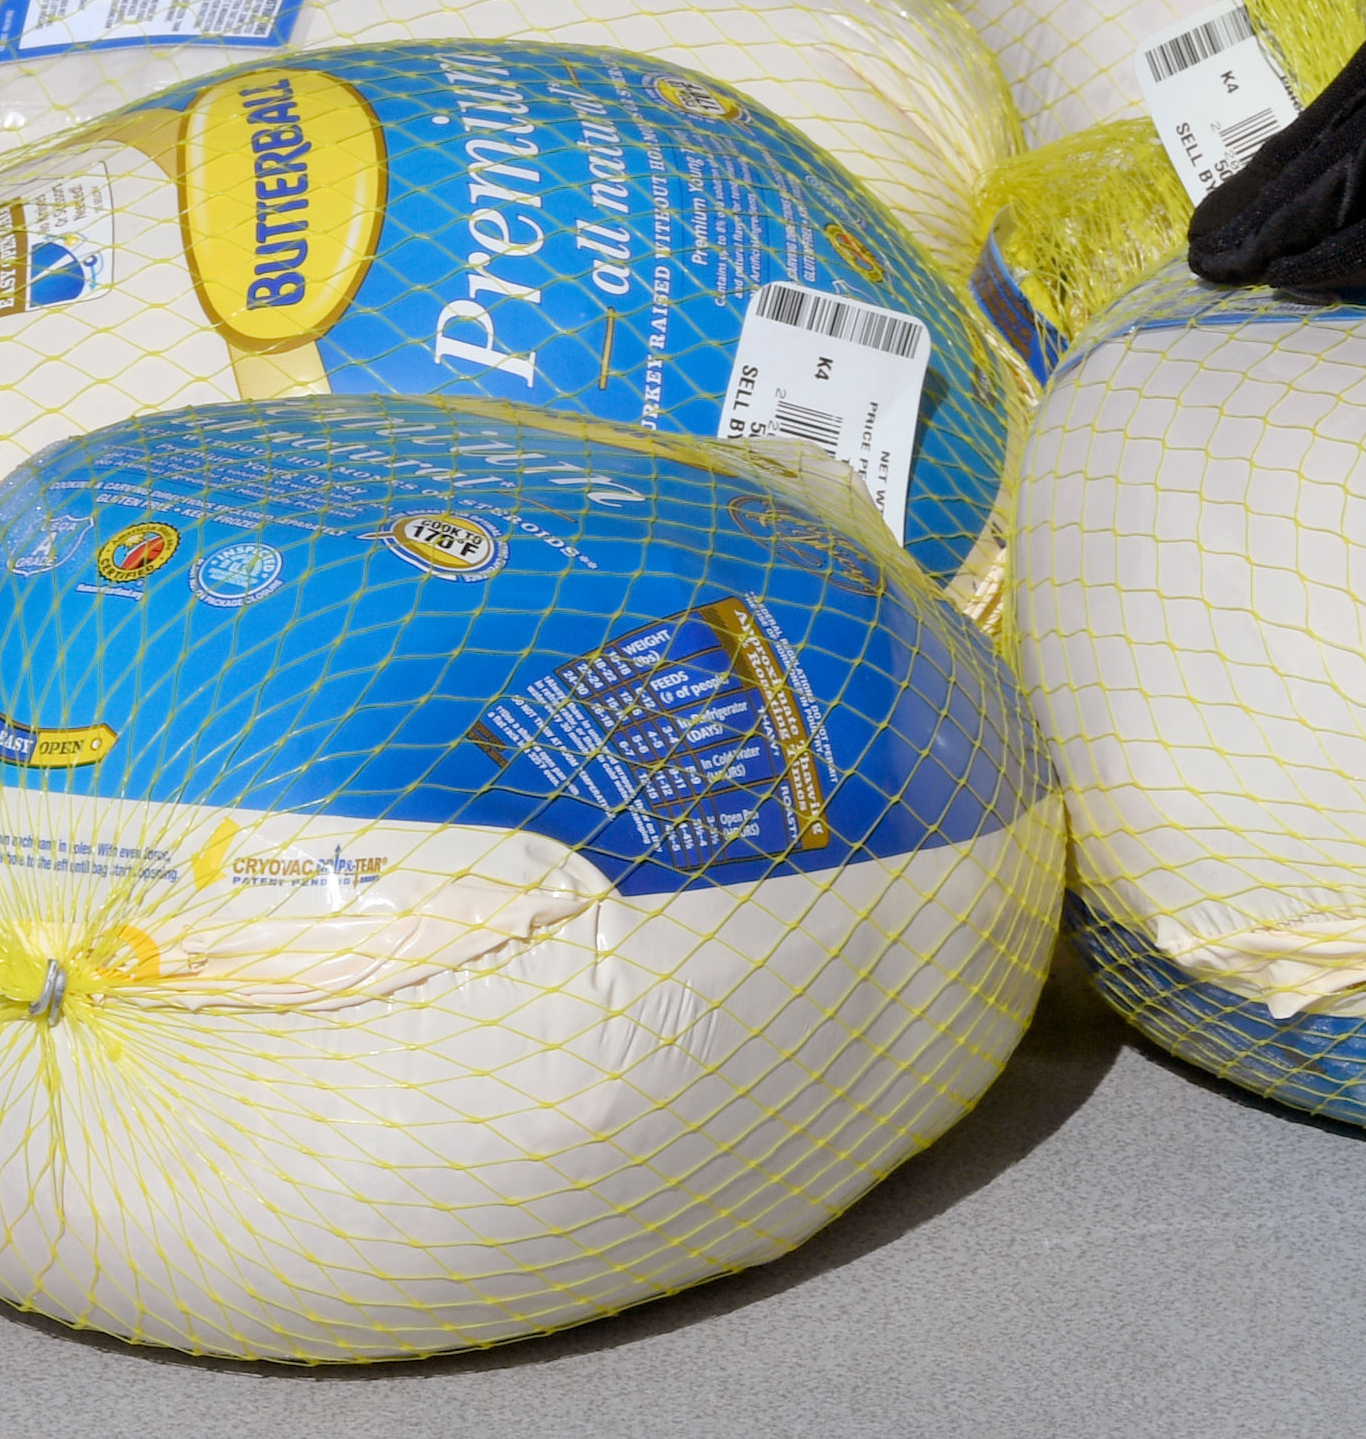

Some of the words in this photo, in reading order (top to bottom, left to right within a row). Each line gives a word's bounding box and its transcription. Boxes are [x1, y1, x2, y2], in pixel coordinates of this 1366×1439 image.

[1219, 70, 1240, 94] K4
[1175, 122, 1203, 168] SELL
[239, 78, 313, 311] BUTTERBALL
[432, 52, 546, 389] Premium
[691, 198, 708, 266] Premium
[577, 217, 632, 297] all
[649, 265, 672, 350] RAISED
[814, 356, 833, 381] K4
[640, 355, 665, 431] URKEY
[733, 365, 758, 411] SELL
[860, 402, 878, 451] PRICE
[857, 458, 869, 479] PE
[879, 450, 890, 483] NET
[34, 532, 58, 556] A
[421, 518, 462, 537] COOK
[464, 530, 483, 546] TO
[622, 629, 672, 655] WEIGHT
[594, 657, 618, 684] 18-22
[633, 650, 661, 668] (lbs)
[650, 671, 689, 691] FEEDS
[676, 686, 690, 698] of
[799, 695, 809, 709] IN
[811, 704, 822, 720] DO
[520, 703, 538, 720] NOT
[533, 717, 555, 740] THAW
[549, 735, 563, 748] AT
[559, 721, 573, 734] 30
[687, 725, 724, 744] (DAYS)
[39, 740, 84, 755] OPEN
[487, 710, 496, 718] a
[492, 714, 508, 729] flat
[502, 725, 521, 743] rack
[542, 768, 561, 788] oven.
[618, 740, 636, 758] 6-7
[632, 735, 650, 754] 5-6
[647, 730, 664, 749] 4-5
[539, 750, 556, 769] open
[551, 766, 567, 782] pan
[575, 726, 587, 737] or
[602, 761, 619, 782] cold
[700, 759, 712, 770] In
[712, 752, 733, 767] Cold
[581, 719, 593, 730] in
[645, 821, 657, 836] on
[719, 811, 742, 827] Open
[233, 856, 314, 876] CRYOVAC
[233, 876, 284, 886] PATENT
